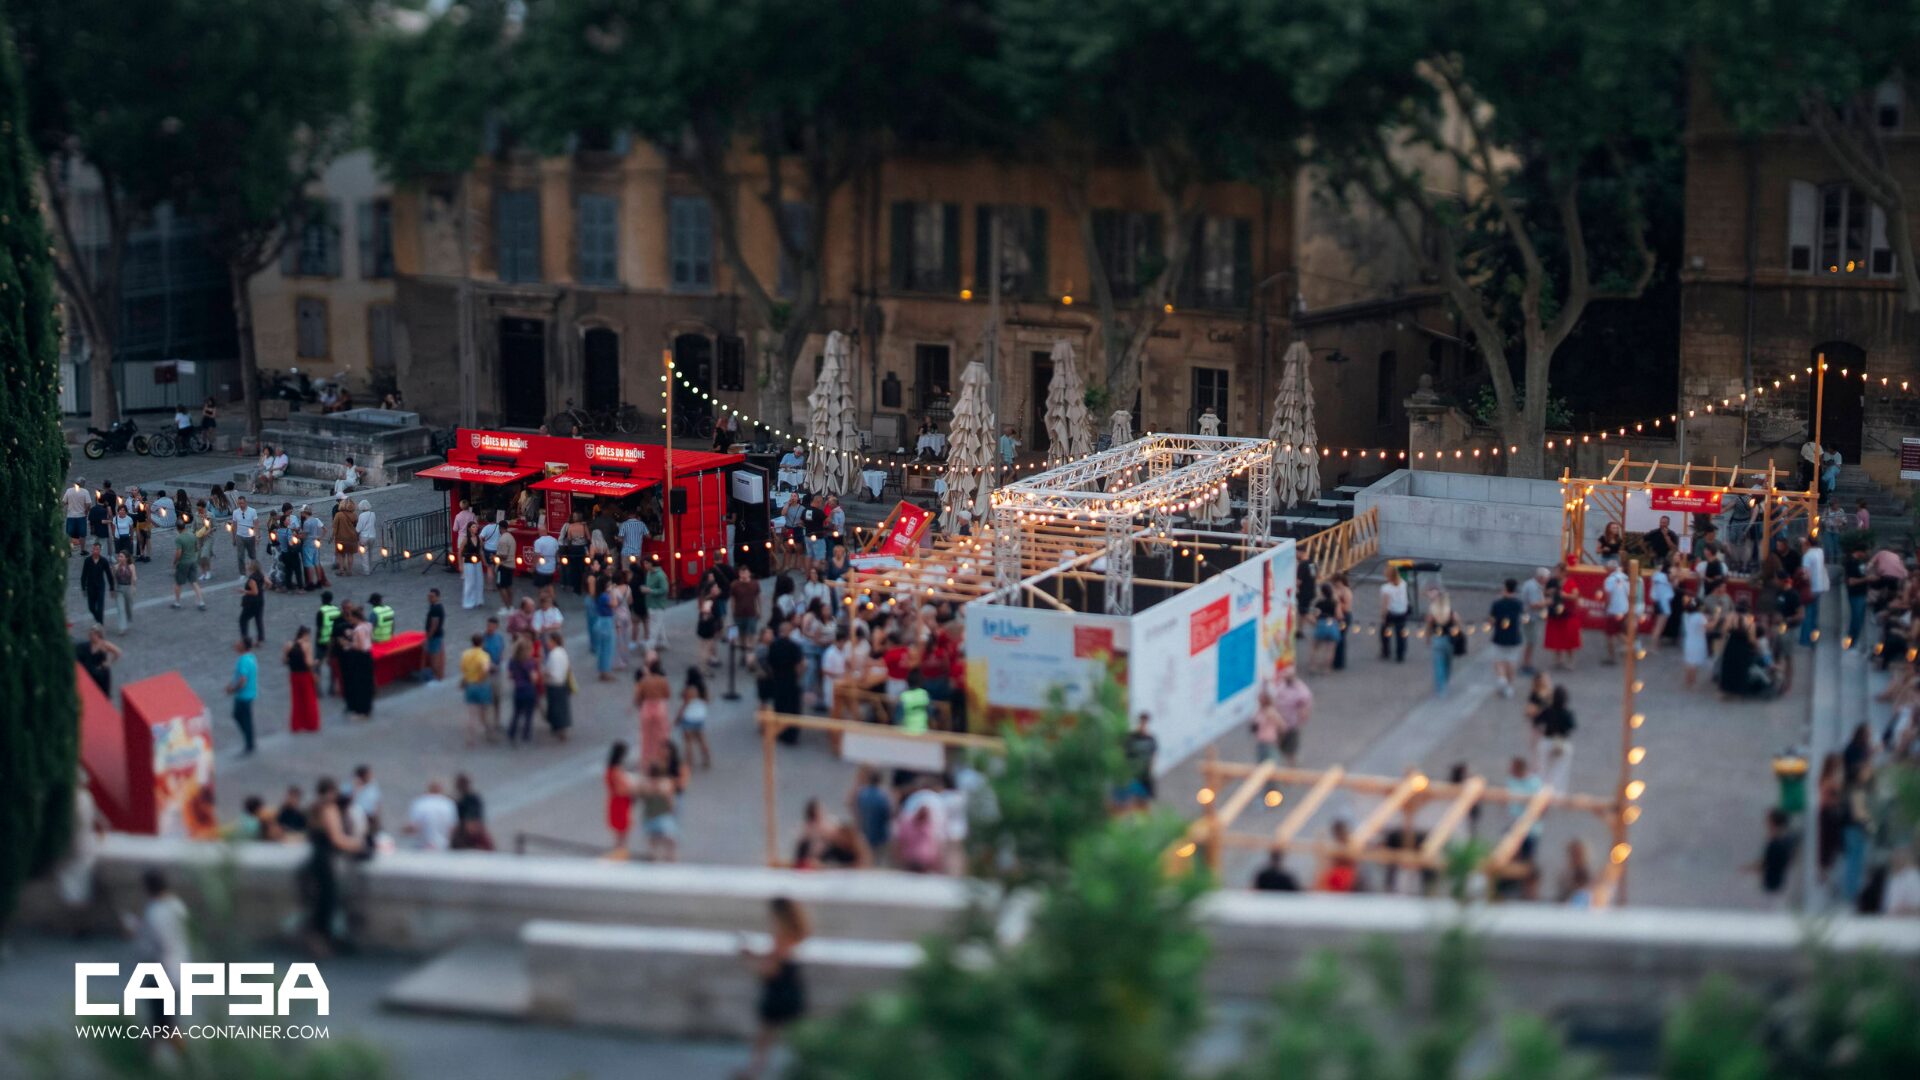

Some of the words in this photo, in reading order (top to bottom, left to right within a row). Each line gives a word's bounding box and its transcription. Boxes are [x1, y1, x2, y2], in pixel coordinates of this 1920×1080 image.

[481, 435, 500, 446] CÔTES
[500, 437, 508, 448] DU
[509, 437, 528, 449] RHÔNE
[596, 444, 615, 457] CÔTES
[615, 448, 624, 458] DU
[625, 447, 646, 459] RHÔNE
